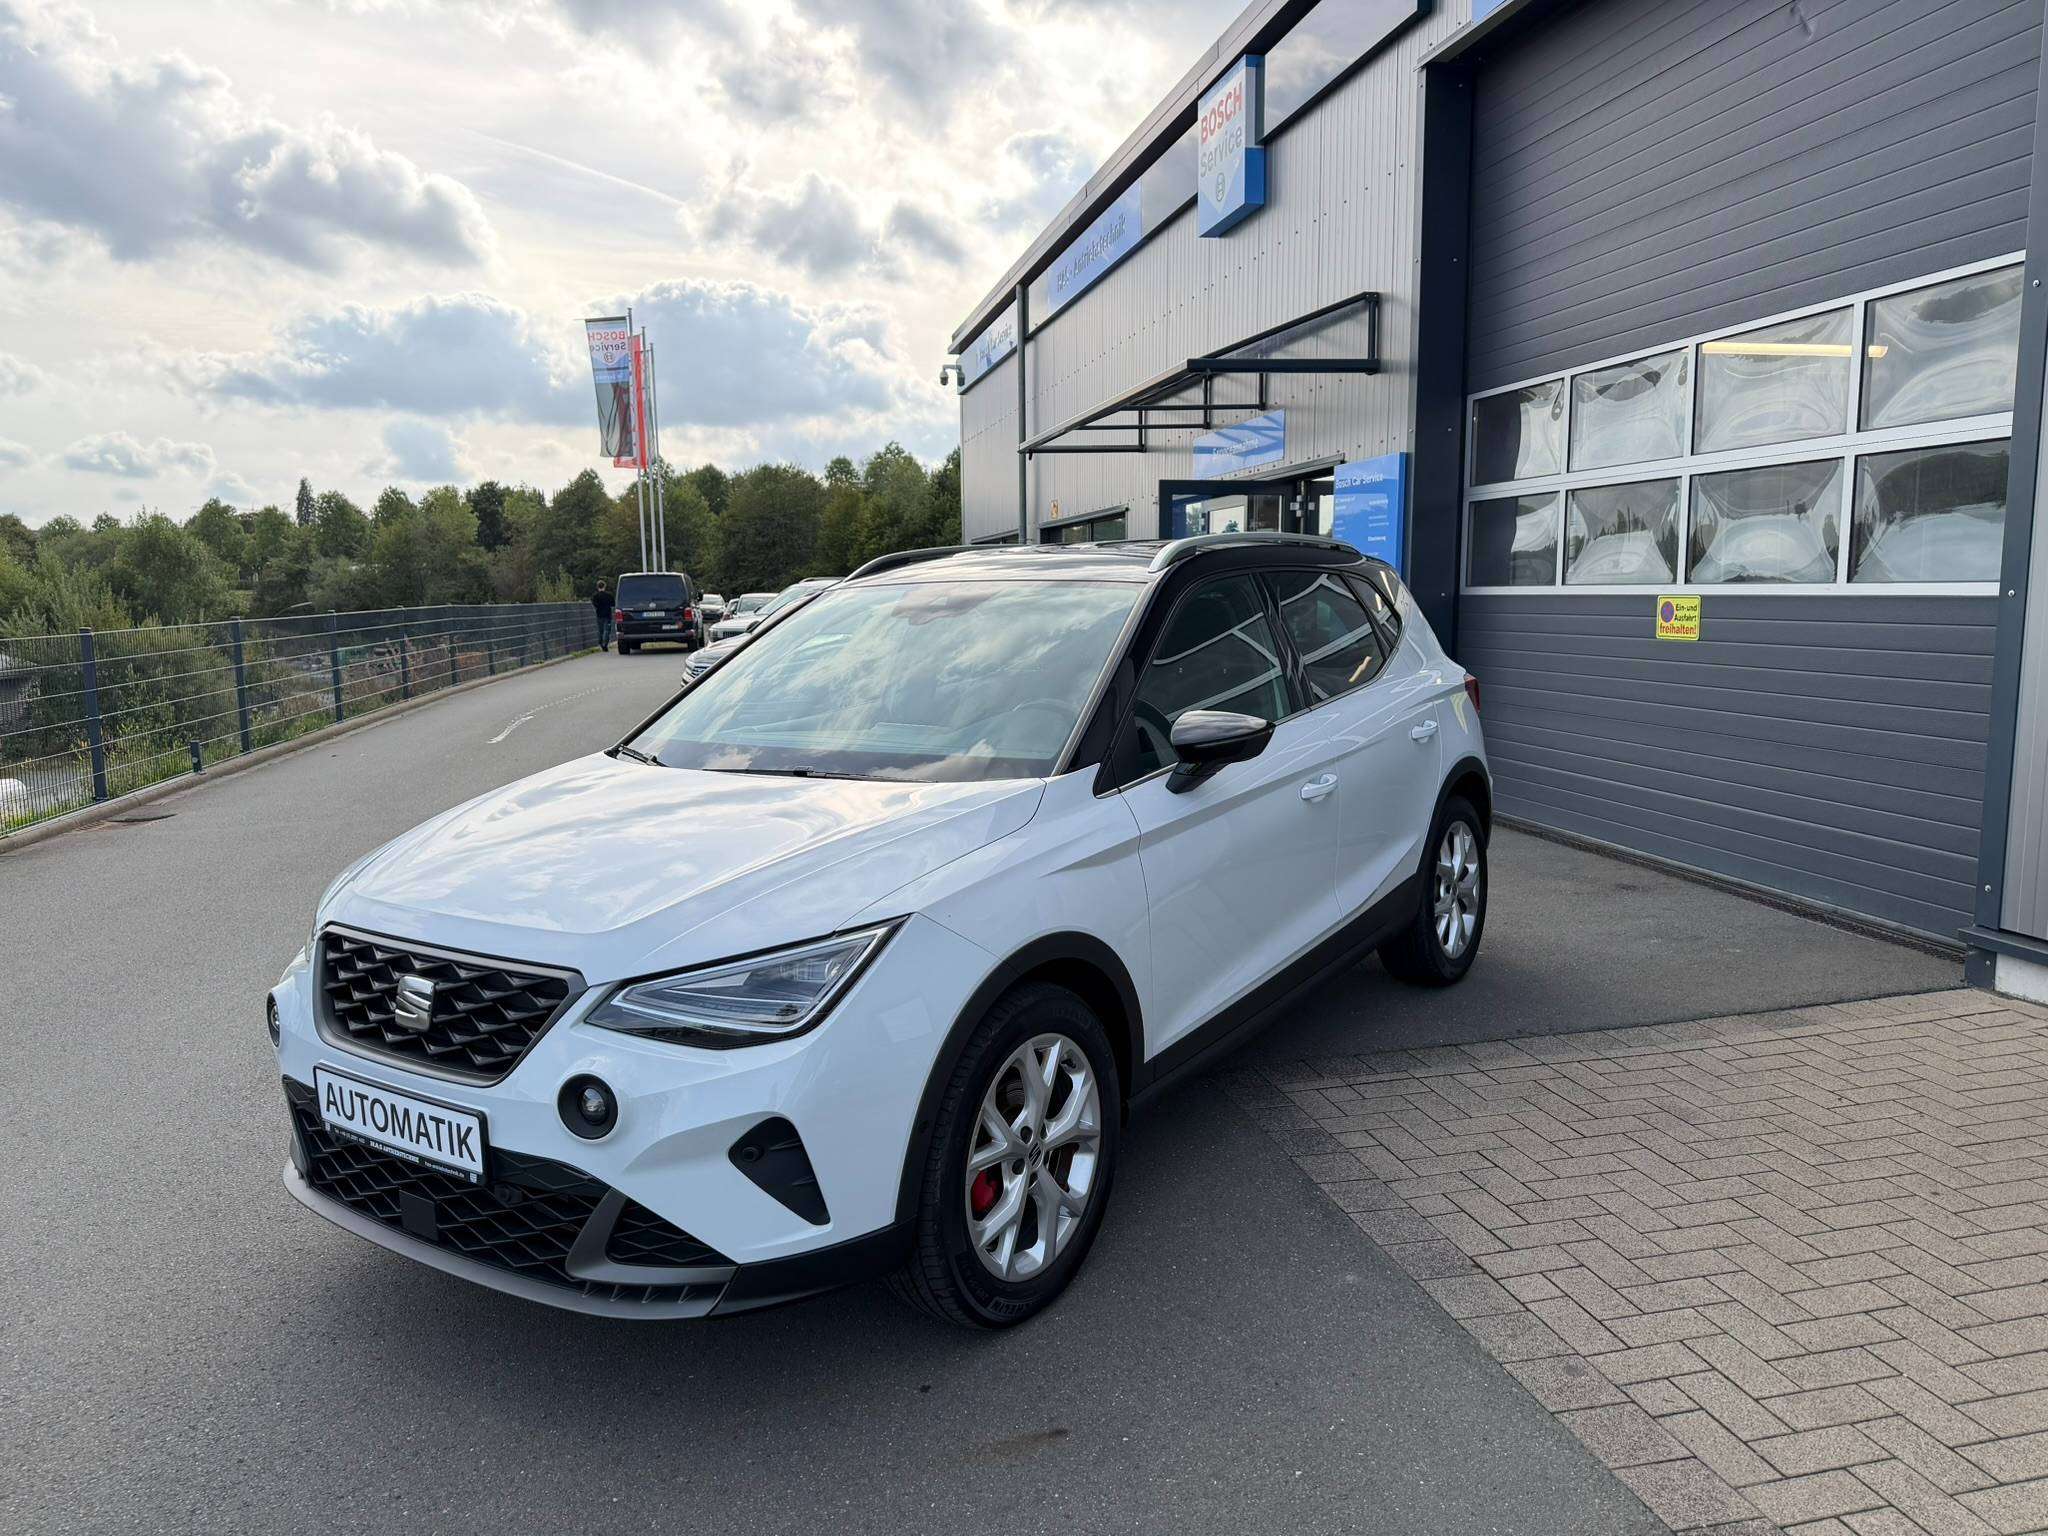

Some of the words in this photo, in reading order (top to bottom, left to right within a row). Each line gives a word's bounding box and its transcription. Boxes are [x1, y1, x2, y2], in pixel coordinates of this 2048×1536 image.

[1201, 81, 1243, 144] BOSCH
[1200, 126, 1243, 178] Service
[1660, 622, 1696, 635] freihalten!
[1674, 613, 1696, 622] Ausfahrt
[326, 1082, 477, 1163] AUTOMATIK
